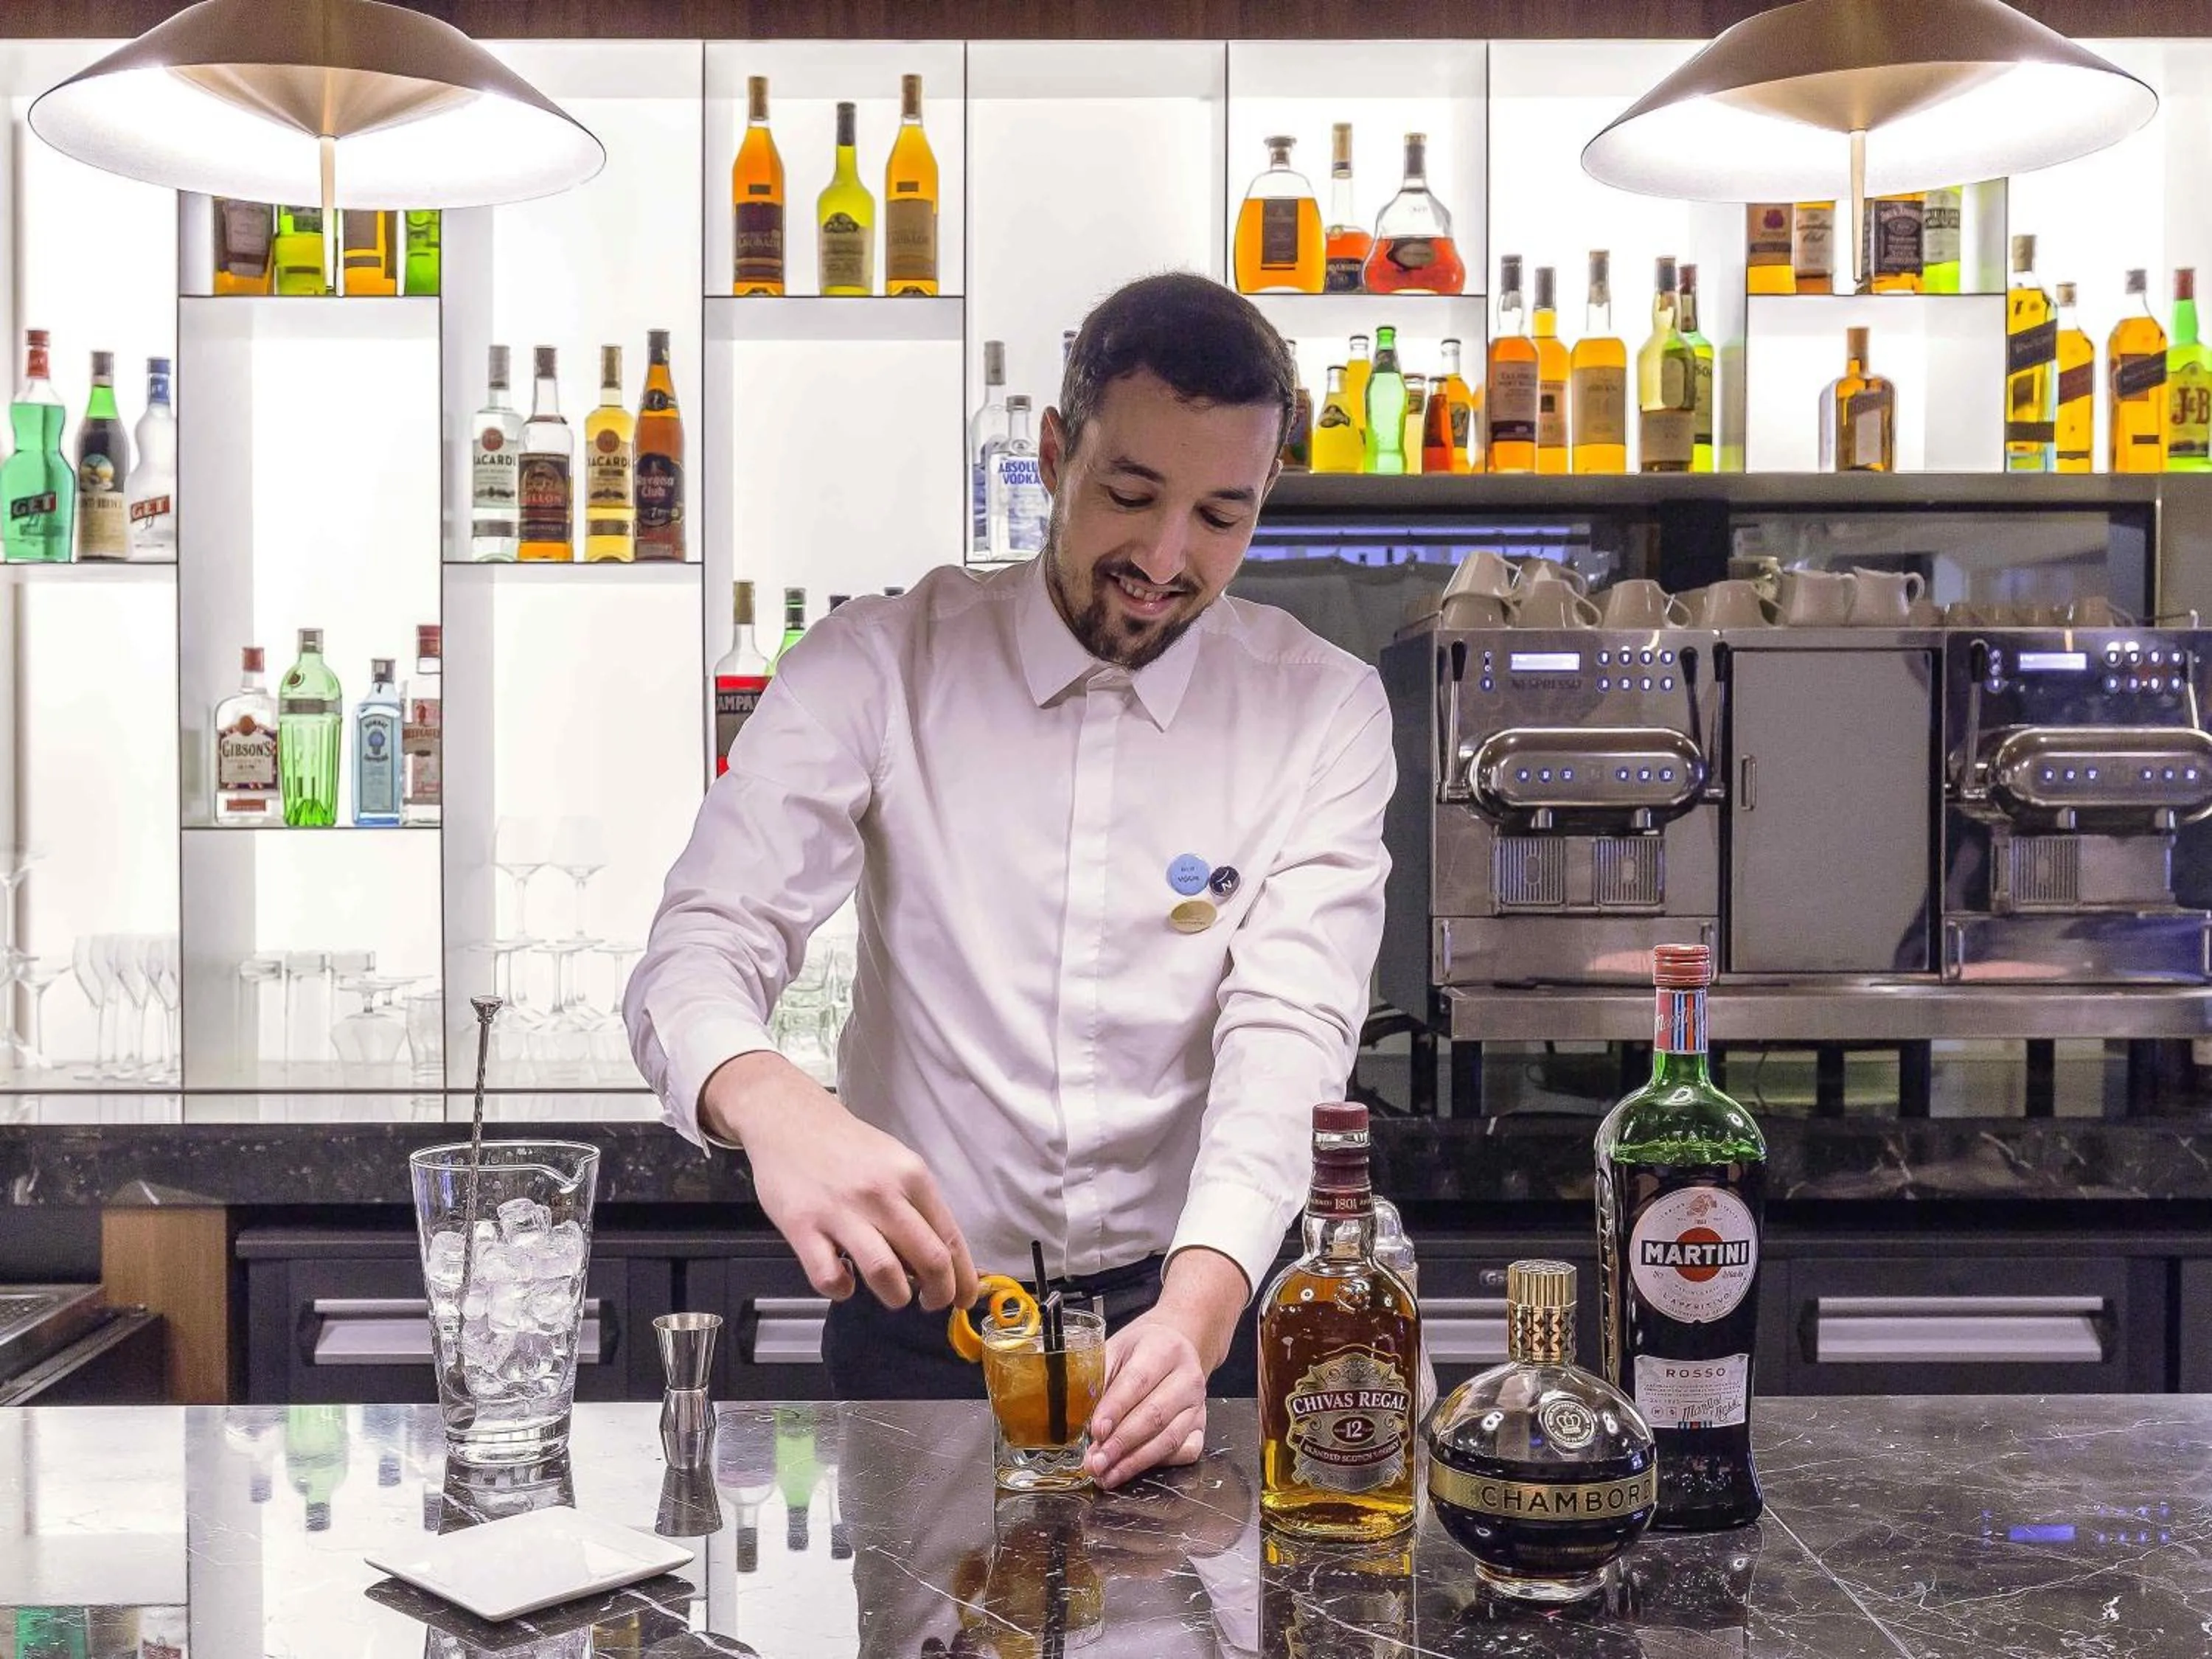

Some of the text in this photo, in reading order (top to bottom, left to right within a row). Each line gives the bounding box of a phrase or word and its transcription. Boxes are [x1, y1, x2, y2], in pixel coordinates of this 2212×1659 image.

[998, 461, 1038, 473] ABSOLU
[1003, 473, 1040, 484] VODKA
[132, 497, 167, 518] GET
[717, 695, 760, 711] AMPA
[1645, 1242, 1747, 1265] MARTINI
[1666, 1368, 1726, 1378] ROSSO
[1293, 1391, 1407, 1414] CHIVAS REGAL
[1346, 1421, 1363, 1438] 12
